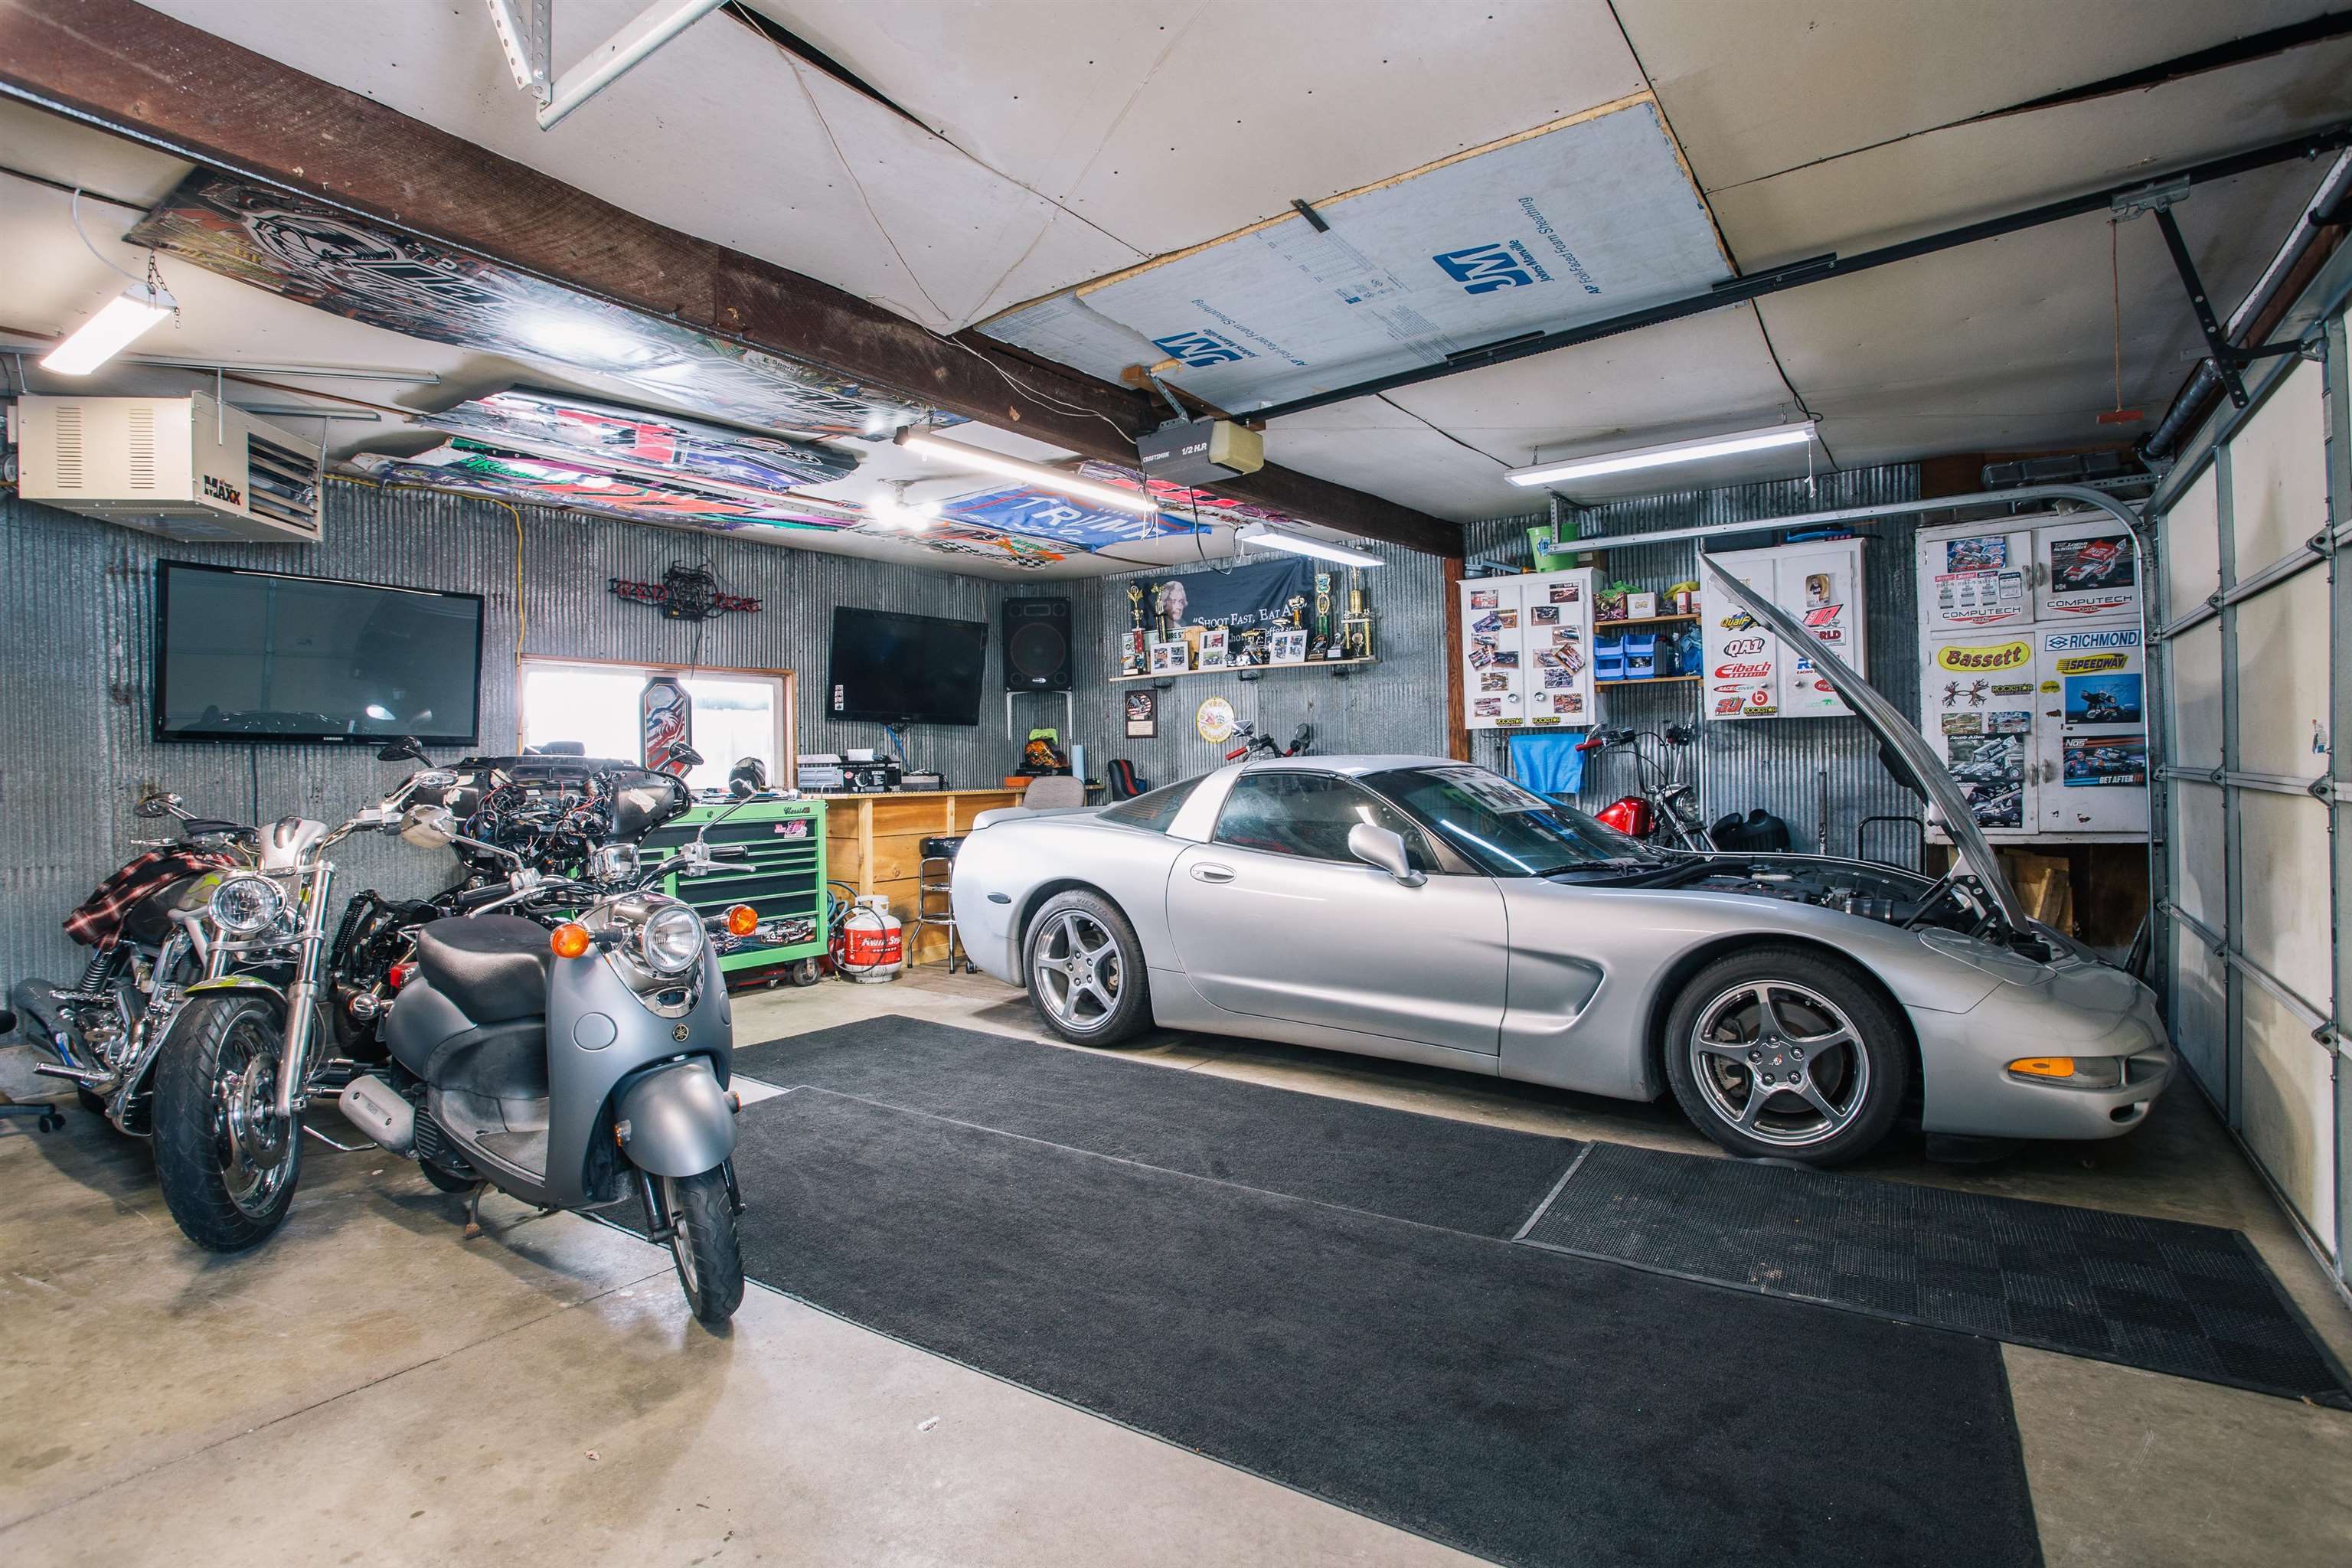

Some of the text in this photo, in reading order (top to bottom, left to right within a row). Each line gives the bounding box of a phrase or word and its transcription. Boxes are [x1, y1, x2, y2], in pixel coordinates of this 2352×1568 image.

[1518, 197, 1553, 235] Sheathing
[1547, 234, 1569, 255] Foam
[1508, 238, 1556, 283] Johns Manville
[1562, 252, 1593, 284] Foil-Faced
[1191, 299, 1236, 325] Sheathing
[1233, 323, 1257, 338] Foam
[1203, 328, 1262, 358] Johns Manville
[1143, 451, 1170, 463] CRAFTSMAN
[1181, 446, 1194, 456] 1/2
[204, 475, 240, 505] MAXX
[618, 580, 669, 601] RED
[2047, 595, 2132, 608] COMPUTECH
[1942, 606, 2021, 619] COMPUTECH
[1728, 639, 1762, 657] QA1
[2069, 632, 2137, 648] RICHMOND
[1946, 646, 2022, 668] Bassett
[2068, 657, 2124, 671] SPEEDWAY
[1715, 662, 1772, 678] Eibach
[1991, 683, 2034, 693] ROCKSTAR
[2066, 738, 2089, 747] NOS
[2099, 776, 2112, 784] GET
[2112, 774, 2134, 783] AFTER
[1076, 897, 1108, 916] VIENTO
